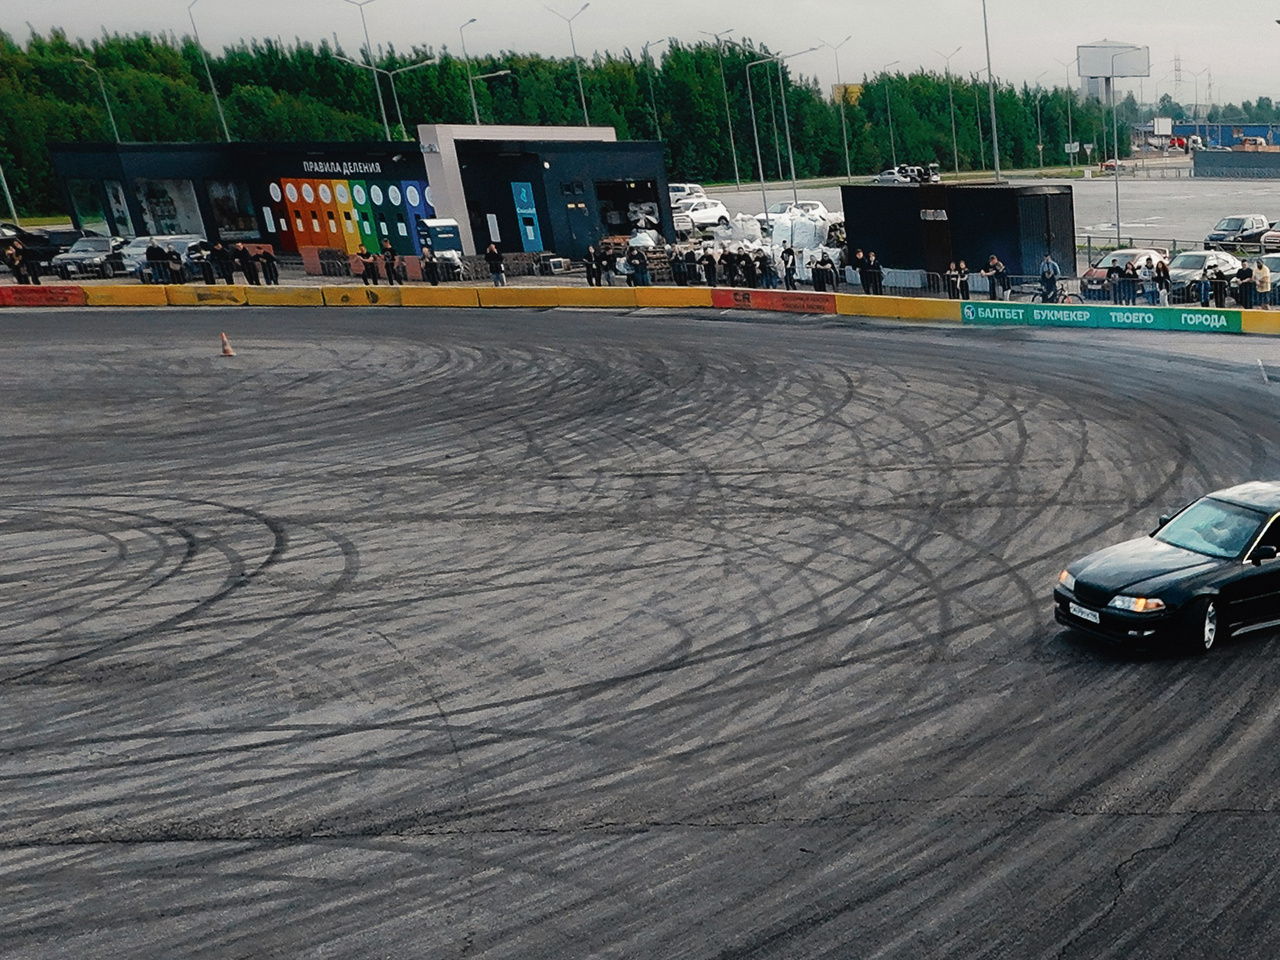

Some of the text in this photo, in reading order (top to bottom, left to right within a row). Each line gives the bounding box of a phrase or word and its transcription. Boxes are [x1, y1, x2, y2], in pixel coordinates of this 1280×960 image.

[303, 161, 381, 175] ПРАВИЛА ДЕЛЕНИЯ
[977, 308, 1228, 328] БАЛТБЕТ БУКМЕКЕР ТВОЕГО ГОРОДА
